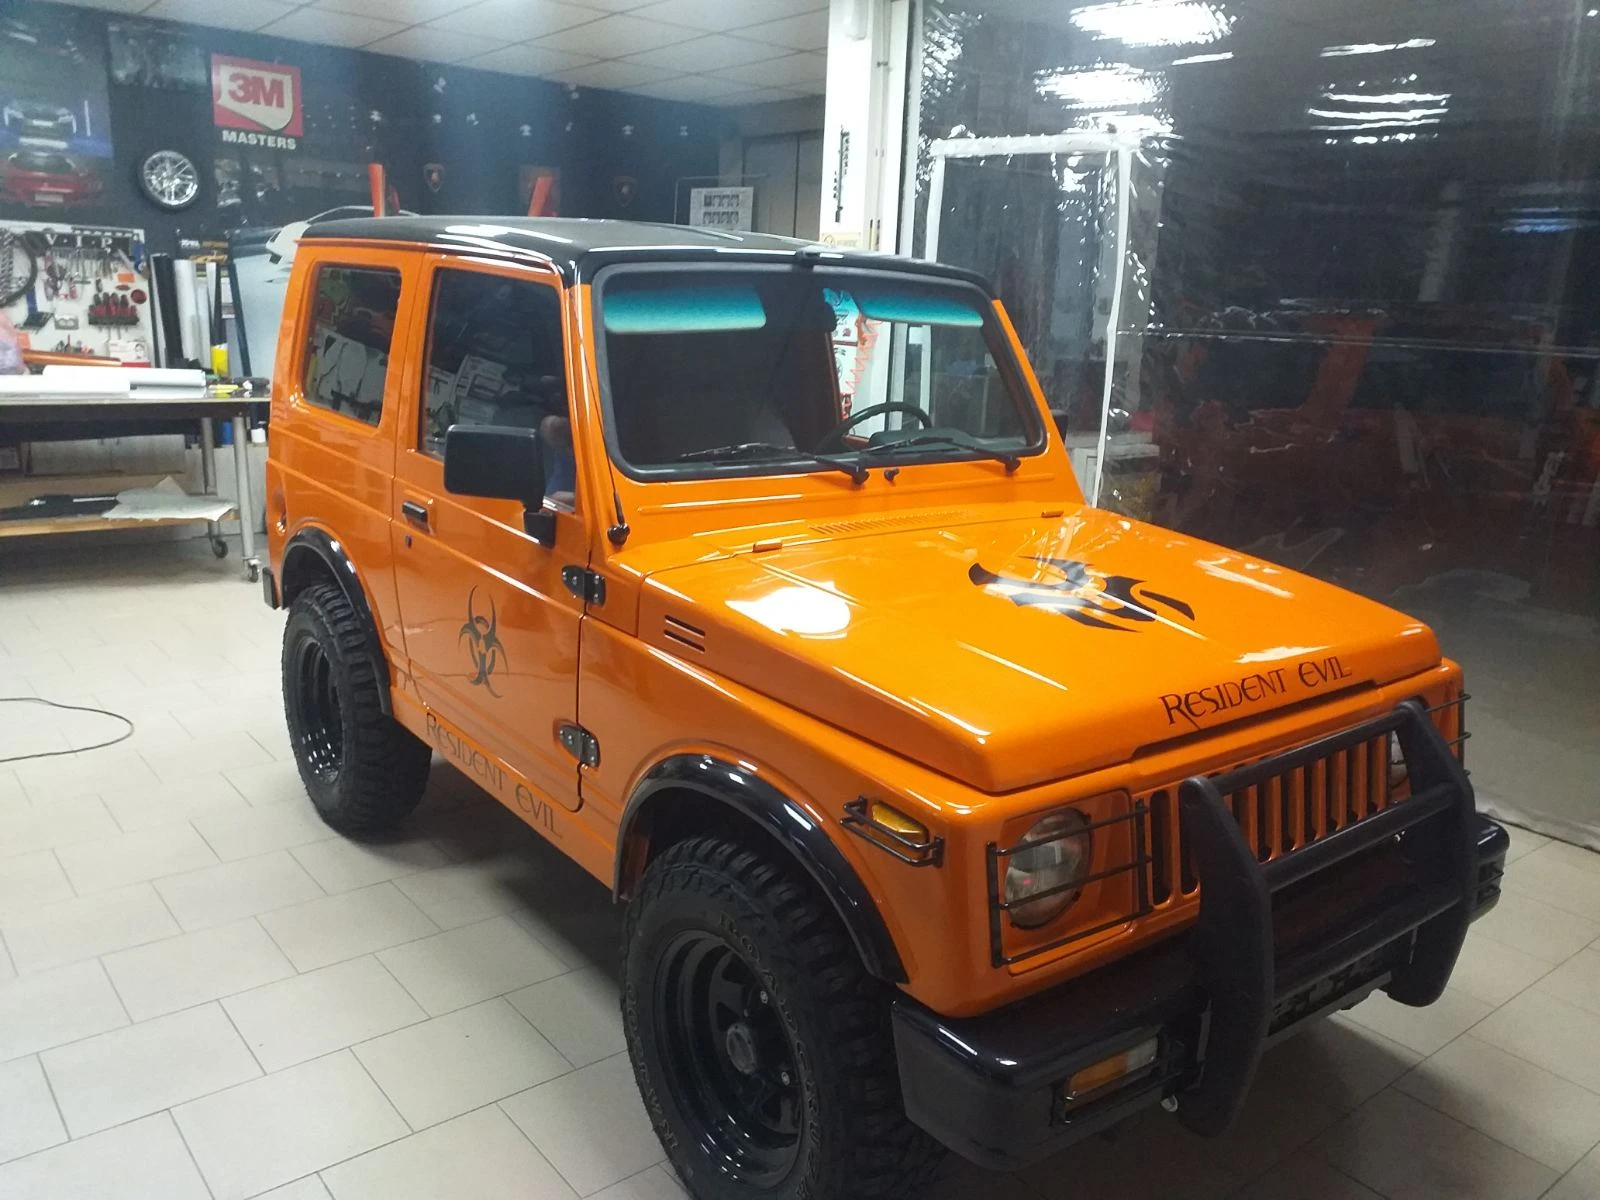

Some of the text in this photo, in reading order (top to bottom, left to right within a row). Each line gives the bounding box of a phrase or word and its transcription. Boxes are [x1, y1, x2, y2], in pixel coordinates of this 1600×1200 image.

[228, 72, 285, 108] 3M
[222, 130, 297, 150] MASTERS
[1159, 655, 1353, 731] RESIDENT EVIL
[426, 711, 563, 840] RESIDENT EVIL
